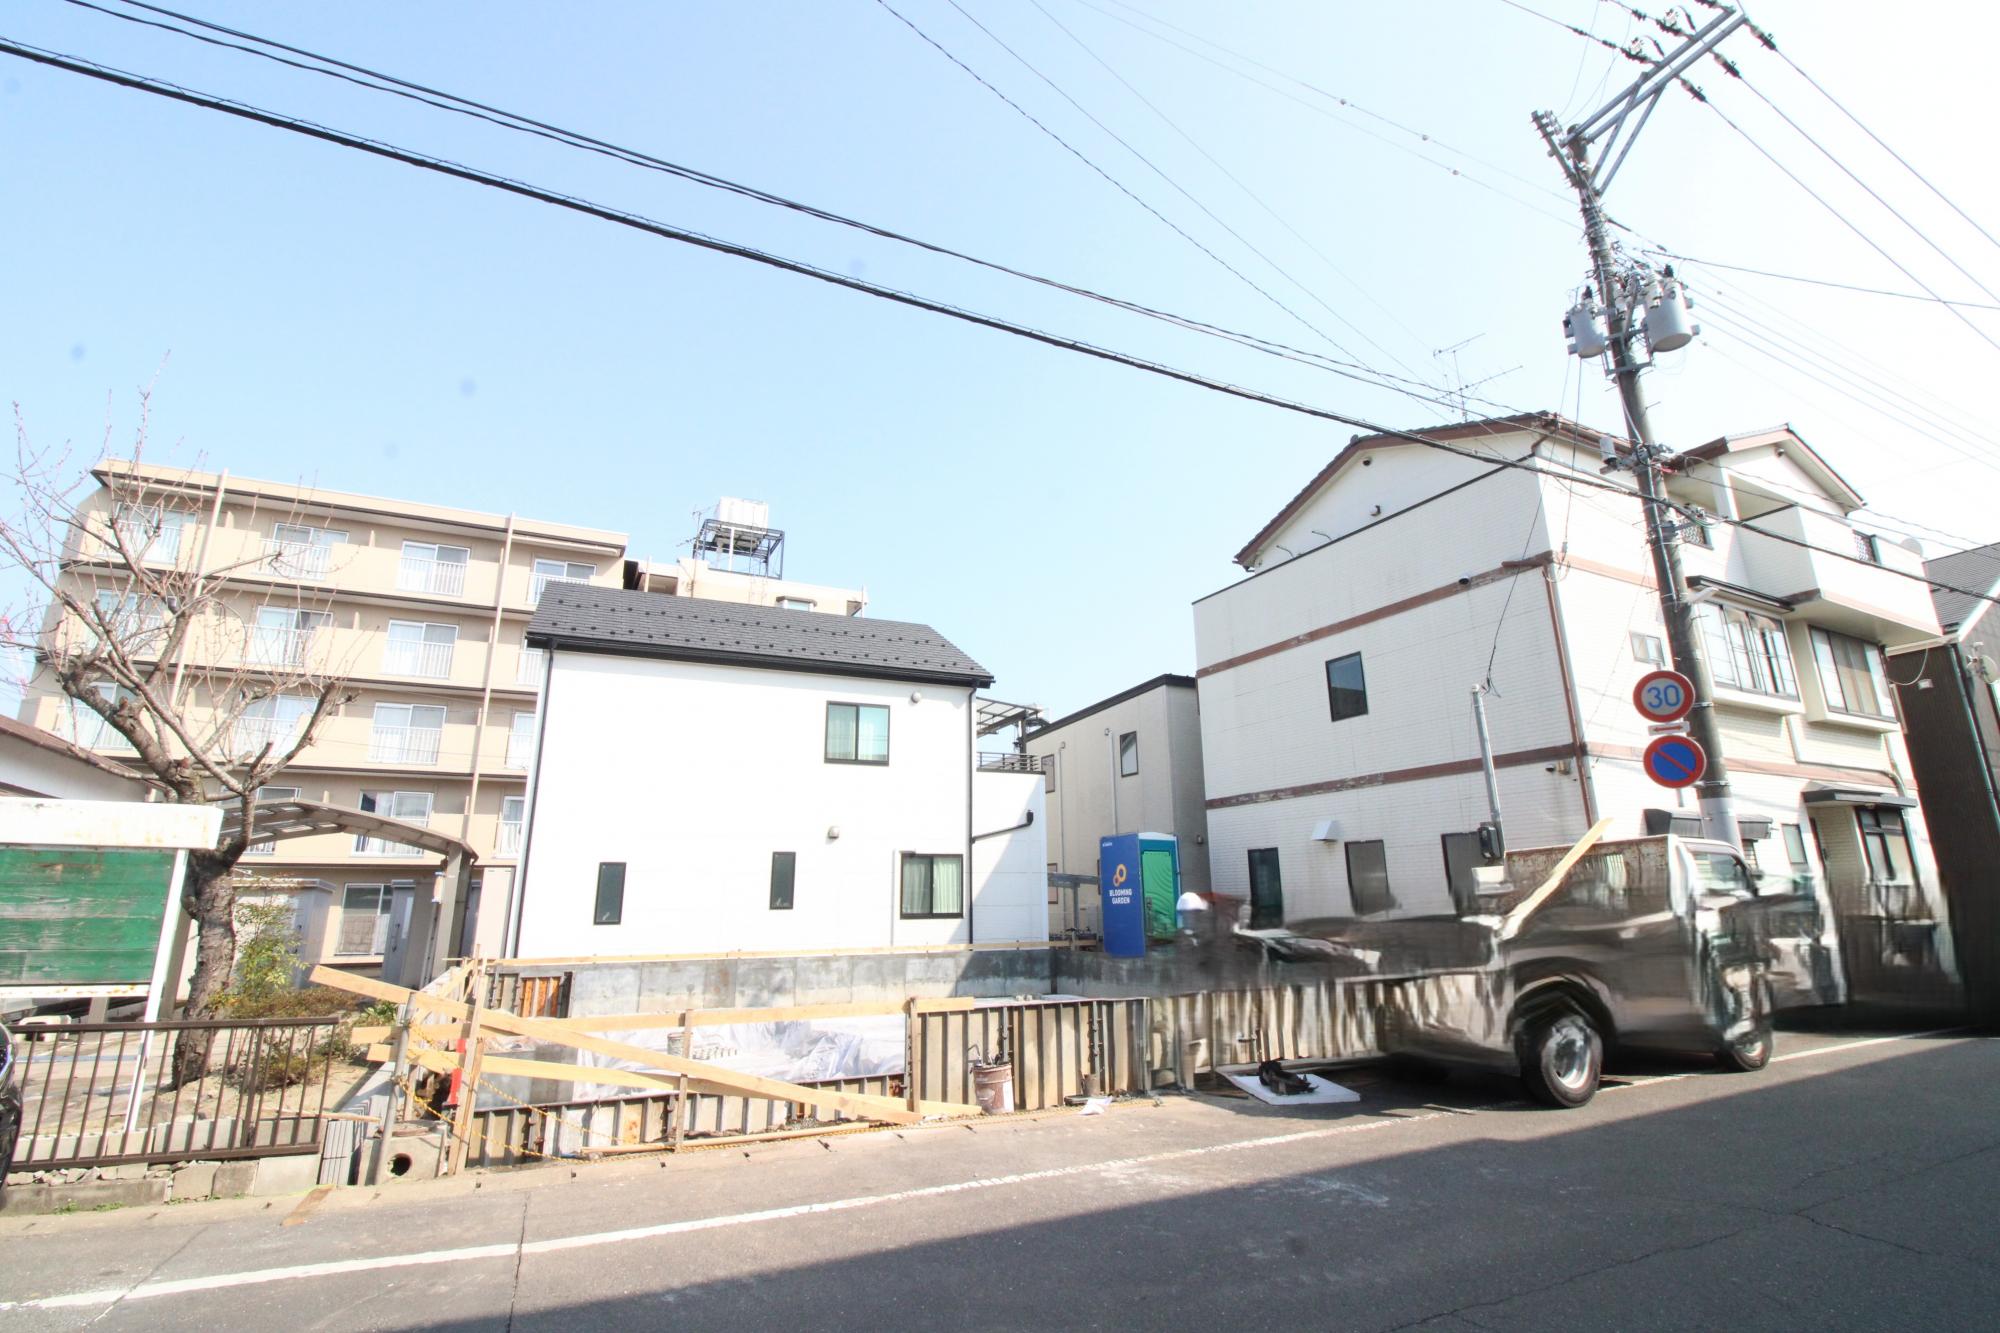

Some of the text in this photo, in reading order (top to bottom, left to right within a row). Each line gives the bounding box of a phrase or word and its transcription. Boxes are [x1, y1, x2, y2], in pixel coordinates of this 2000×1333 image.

[1647, 684, 1681, 709] 30
[1109, 888, 1132, 897] BLOOMING
[1112, 897, 1130, 905] GARDEN
